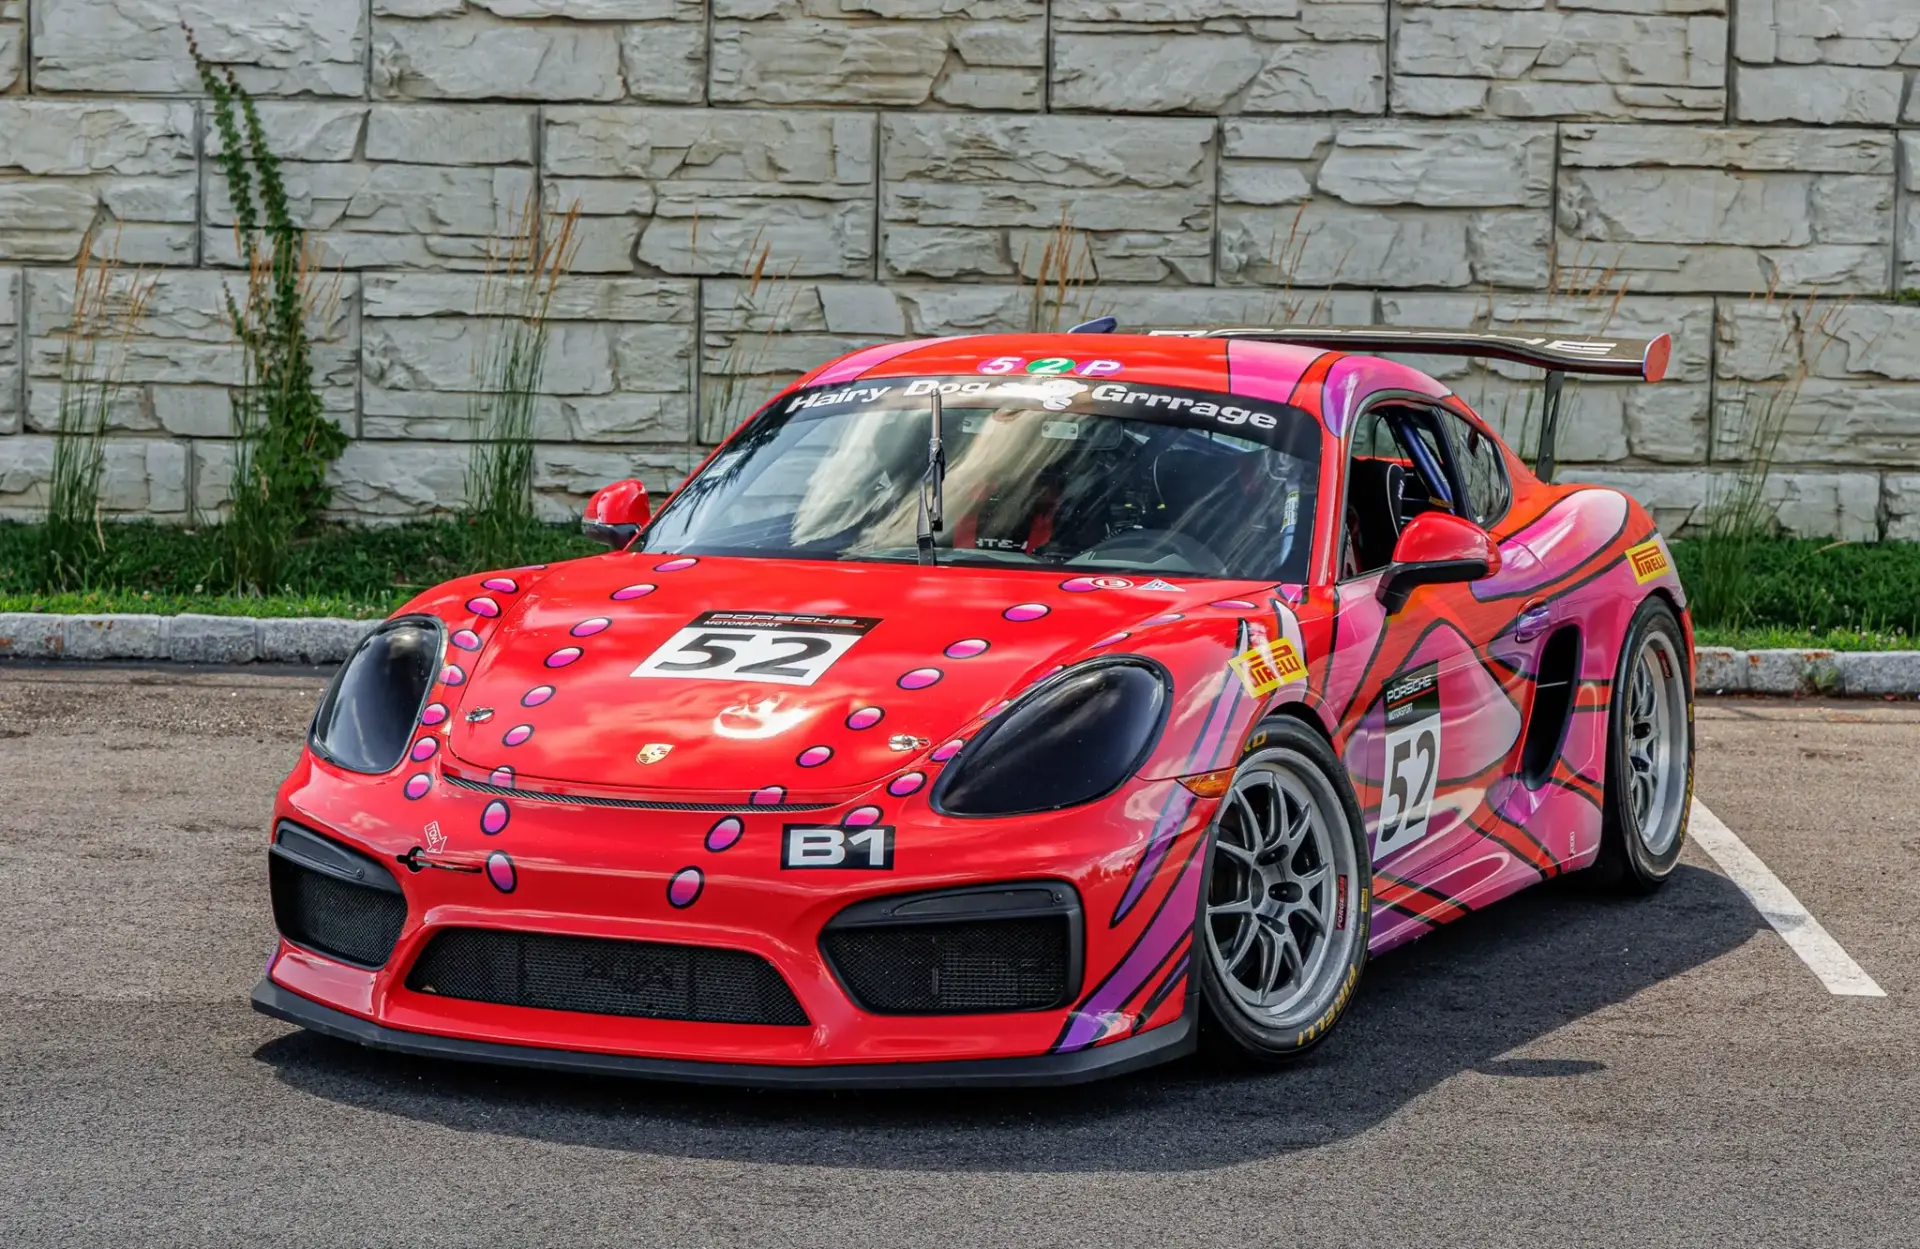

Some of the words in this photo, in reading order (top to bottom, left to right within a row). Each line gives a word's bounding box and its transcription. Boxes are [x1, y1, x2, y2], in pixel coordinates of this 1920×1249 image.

[784, 386, 892, 414] Hairy
[903, 380, 991, 397] Dog
[1092, 384, 1277, 429] Grrrage
[1631, 545, 1667, 577] PIRELLI
[703, 620, 782, 628] MOTORSPORT
[711, 613, 856, 625] PORSCHE
[655, 633, 832, 677] 52
[1240, 644, 1302, 689] PIRELLI
[1387, 675, 1432, 703] PORSCHE
[1381, 730, 1436, 842] 52
[428, 823, 440, 845] TOW
[788, 829, 885, 866] B1
[1297, 963, 1357, 1046] PIRELLI
